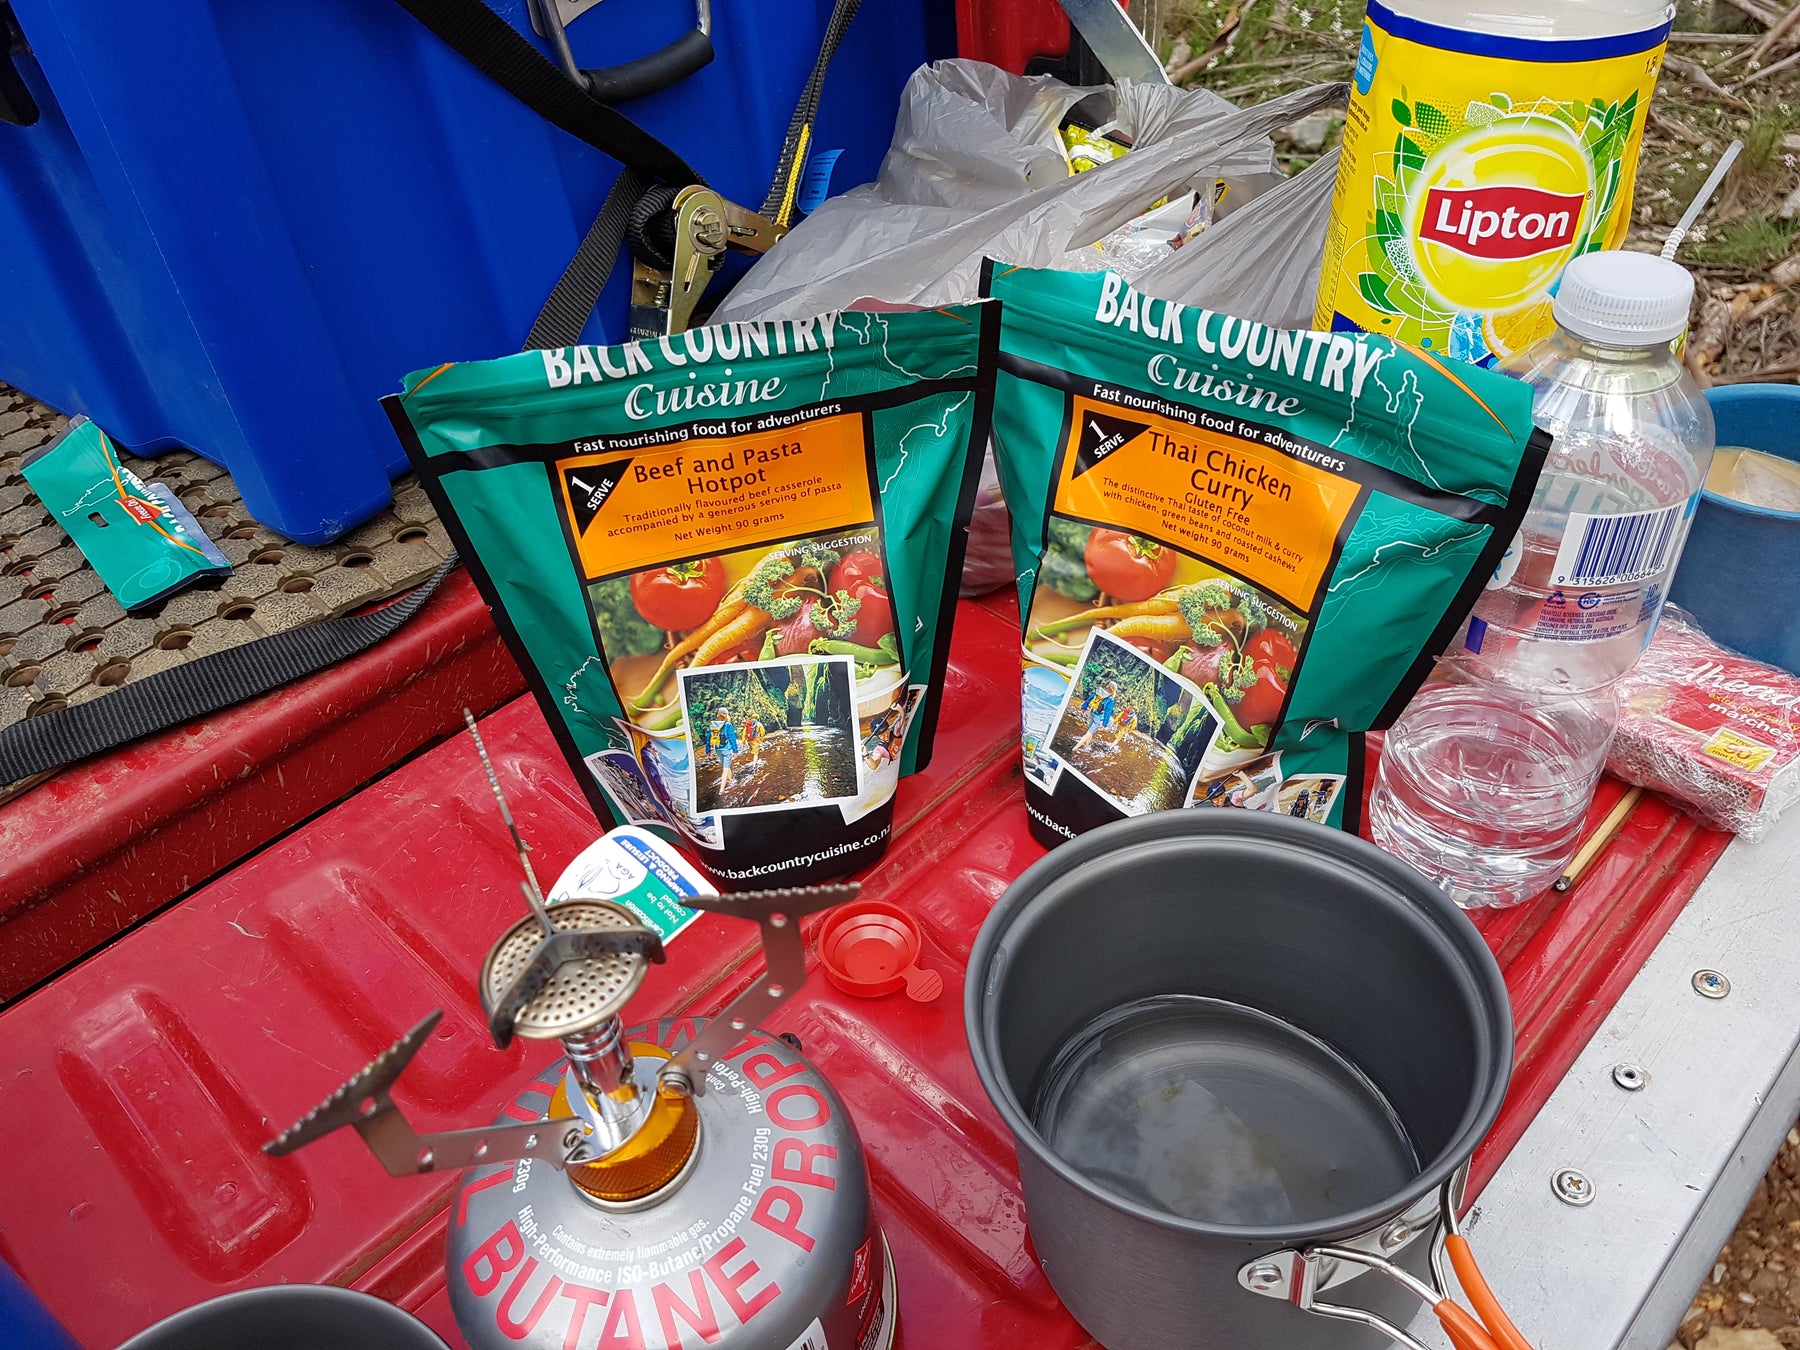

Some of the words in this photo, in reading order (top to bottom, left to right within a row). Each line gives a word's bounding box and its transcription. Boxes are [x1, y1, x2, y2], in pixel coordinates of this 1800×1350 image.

[1435, 198, 1570, 246] Lipton
[542, 340, 653, 388] BACK
[658, 310, 838, 366] COUNTRY
[1095, 271, 1186, 345] BACK
[1197, 309, 1384, 398] COUNTRY
[624, 368, 787, 420] Cuisine
[1147, 353, 1306, 417] Cuisine
[574, 438, 605, 453] Fast
[609, 426, 689, 449] nourishing
[692, 421, 728, 437] food
[731, 419, 753, 433] for
[757, 402, 842, 429] adventurers
[1088, 419, 1108, 443] 1
[1093, 384, 1120, 403] Fast
[1124, 393, 1197, 425] nourishing
[1200, 414, 1234, 433] food
[1238, 421, 1260, 439] for
[1263, 430, 1346, 472] adventurers
[1093, 432, 1125, 459] SERVE
[633, 456, 684, 484] Beef
[692, 454, 735, 474] and
[743, 441, 803, 467] Pasta
[687, 468, 767, 494] Hotpot
[1148, 430, 1198, 464] Thai
[1206, 450, 1291, 502] Chicken
[571, 474, 596, 497] 1
[586, 477, 615, 511] SERVE
[623, 502, 693, 524] Traditionally
[695, 493, 746, 509] flavoured
[748, 486, 772, 500] beef
[774, 476, 823, 494] casserole
[1190, 468, 1254, 511] Curry
[607, 515, 679, 538] accompanied
[682, 513, 696, 523] by
[698, 511, 705, 519] a
[707, 502, 757, 519] generous
[759, 493, 798, 508] serving
[800, 487, 812, 498] of
[814, 482, 843, 497] pasta
[674, 531, 694, 542] Net
[695, 523, 733, 537] Weight
[735, 519, 750, 530] 90
[752, 512, 785, 528] grams
[1103, 477, 1119, 489] The
[1121, 483, 1165, 503] distinctive
[1167, 497, 1187, 511] Thai
[1188, 504, 1209, 519] taste
[1211, 514, 1222, 523] of
[1222, 519, 1255, 538] coconut
[1255, 533, 1274, 548] milk
[1273, 541, 1281, 551] &
[1282, 547, 1305, 564] curry
[1184, 491, 1223, 515] Gluten
[1226, 506, 1251, 526] Free
[768, 545, 809, 561] SERVING
[811, 534, 873, 552] SUGGESTION
[1103, 490, 1122, 501] with
[1124, 495, 1160, 514] chicken,
[1161, 509, 1187, 523] green
[1188, 516, 1214, 533] beans
[1215, 528, 1232, 540] and
[1233, 536, 1263, 555] roasted
[1264, 551, 1299, 574] cashews.
[1161, 520, 1178, 532] Net
[1179, 527, 1210, 545] weight
[1210, 538, 1223, 550] 90
[1223, 546, 1251, 563] grams
[1557, 575, 1566, 584] 9
[1572, 577, 1616, 586] 315626
[1215, 578, 1251, 601] SERVING
[1251, 596, 1299, 632] SUGGESTION
[1707, 702, 1795, 741] matches
[615, 862, 636, 880] AGA
[620, 839, 650, 864] LEISURE
[644, 849, 679, 881] PRODUCT
[646, 892, 658, 904] be
[655, 869, 689, 898] AMPING
[656, 900, 666, 911] to
[660, 894, 687, 917] copied
[663, 908, 679, 924] Not
[752, 1127, 772, 1162] 230g
[742, 1160, 766, 1197] Fuel
[517, 1204, 613, 1284] High-Performance
[552, 1224, 587, 1257] Contains
[586, 1245, 634, 1264] extremely
[636, 1232, 690, 1260] flammable
[687, 1218, 711, 1243] gas.
[616, 1194, 753, 1286] ISO-Butane/Propane
[461, 1220, 782, 1350] BUTANE
